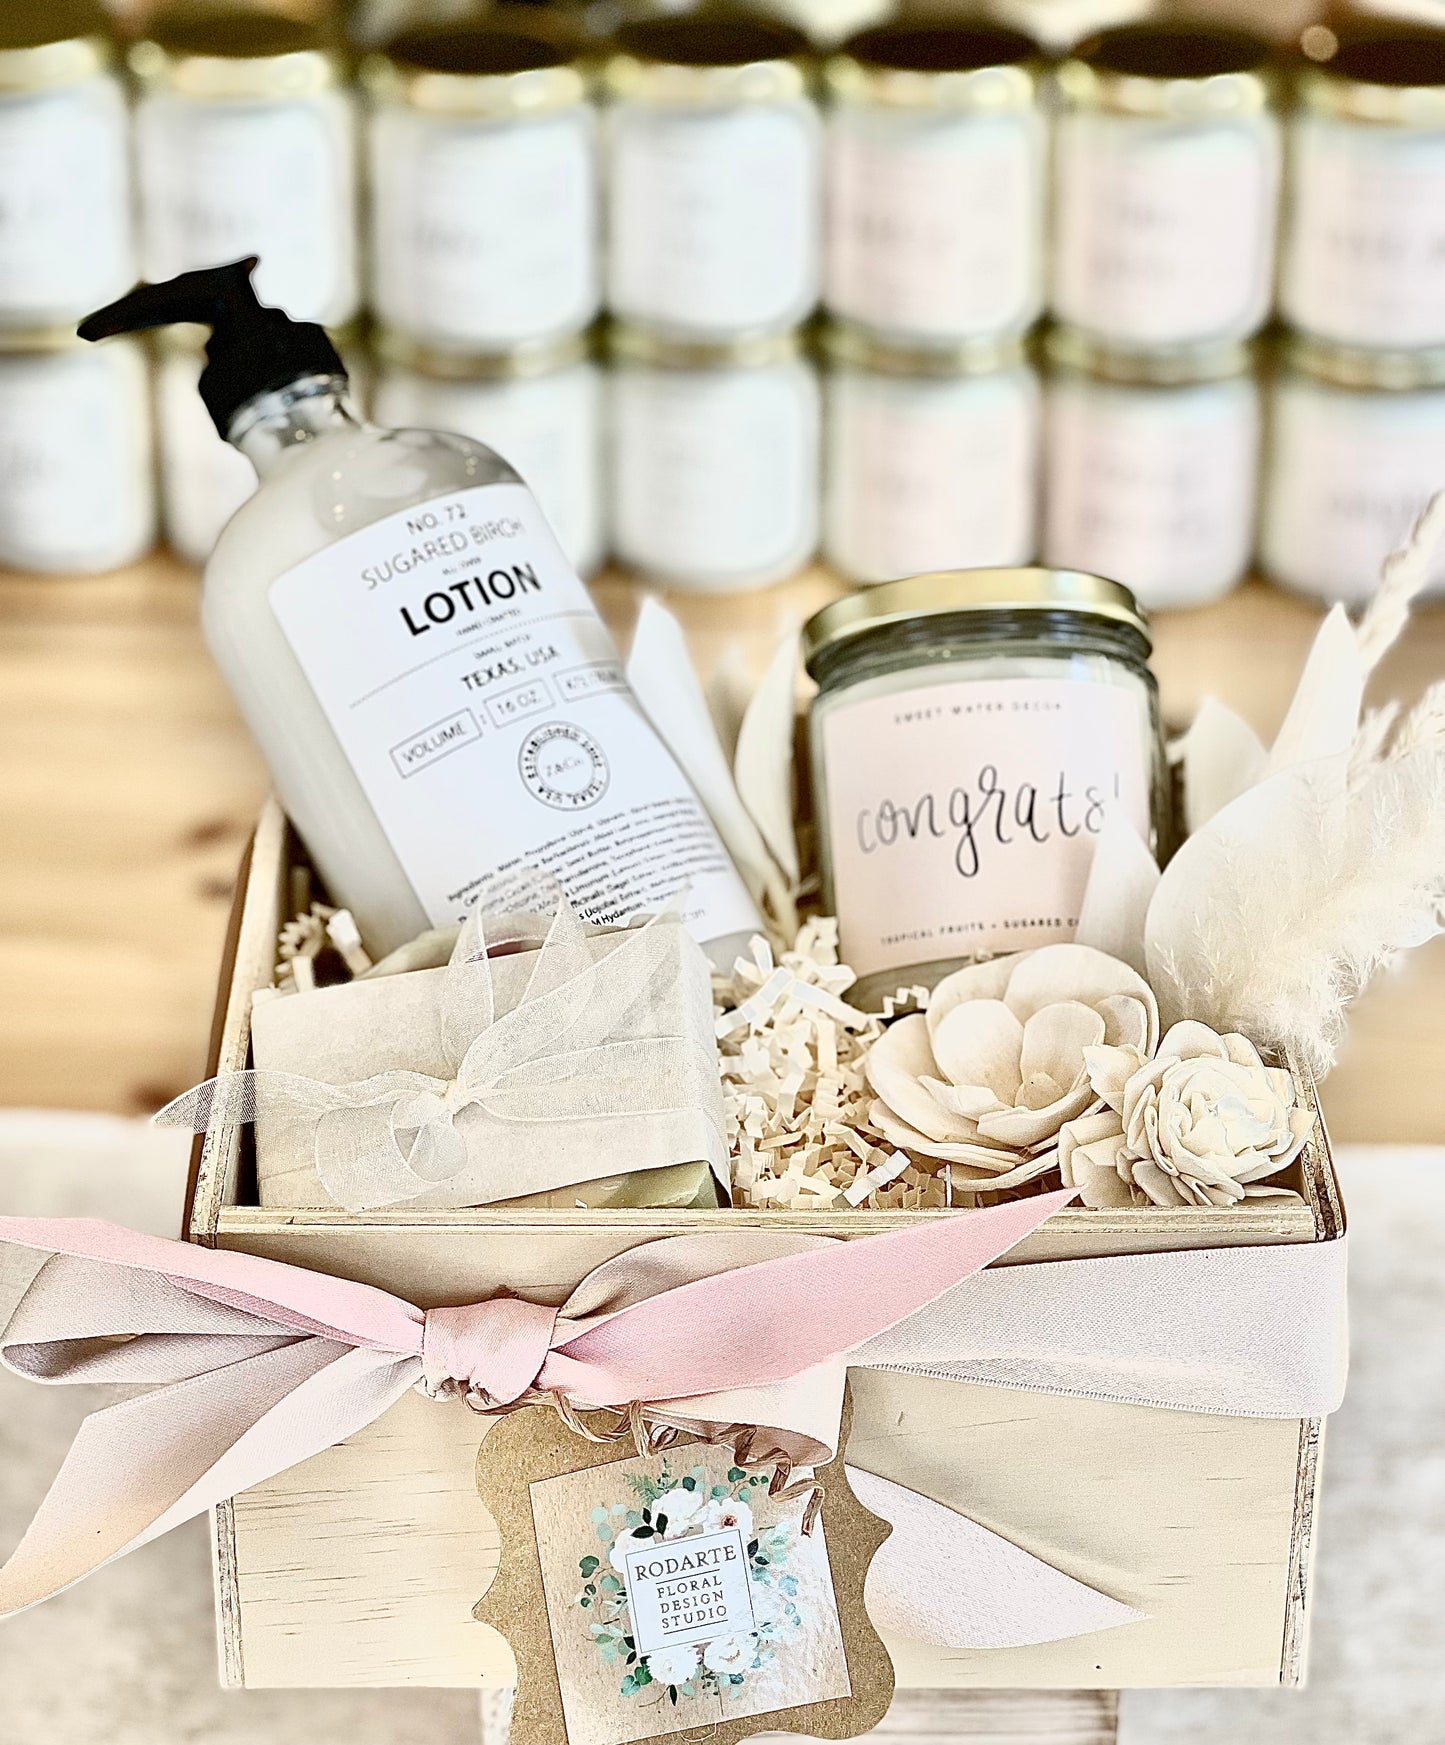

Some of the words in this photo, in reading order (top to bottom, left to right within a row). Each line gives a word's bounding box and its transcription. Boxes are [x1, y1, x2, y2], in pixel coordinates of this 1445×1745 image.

[445, 503, 467, 521] 72
[361, 531, 469, 591] SUGARED
[469, 517, 527, 546] BIRCH
[400, 562, 543, 636] LOTION
[461, 657, 526, 691] TEXAS,
[524, 644, 560, 667] USA
[497, 700, 516, 714] 16
[402, 721, 468, 762] VOLUME
[1003, 917, 1063, 929] SUGARED
[634, 1545, 737, 1581] RODARTE
[657, 1575, 722, 1598] FLORAL
[660, 1590, 723, 1614] DESIGN
[661, 1605, 727, 1629] STUDIO
